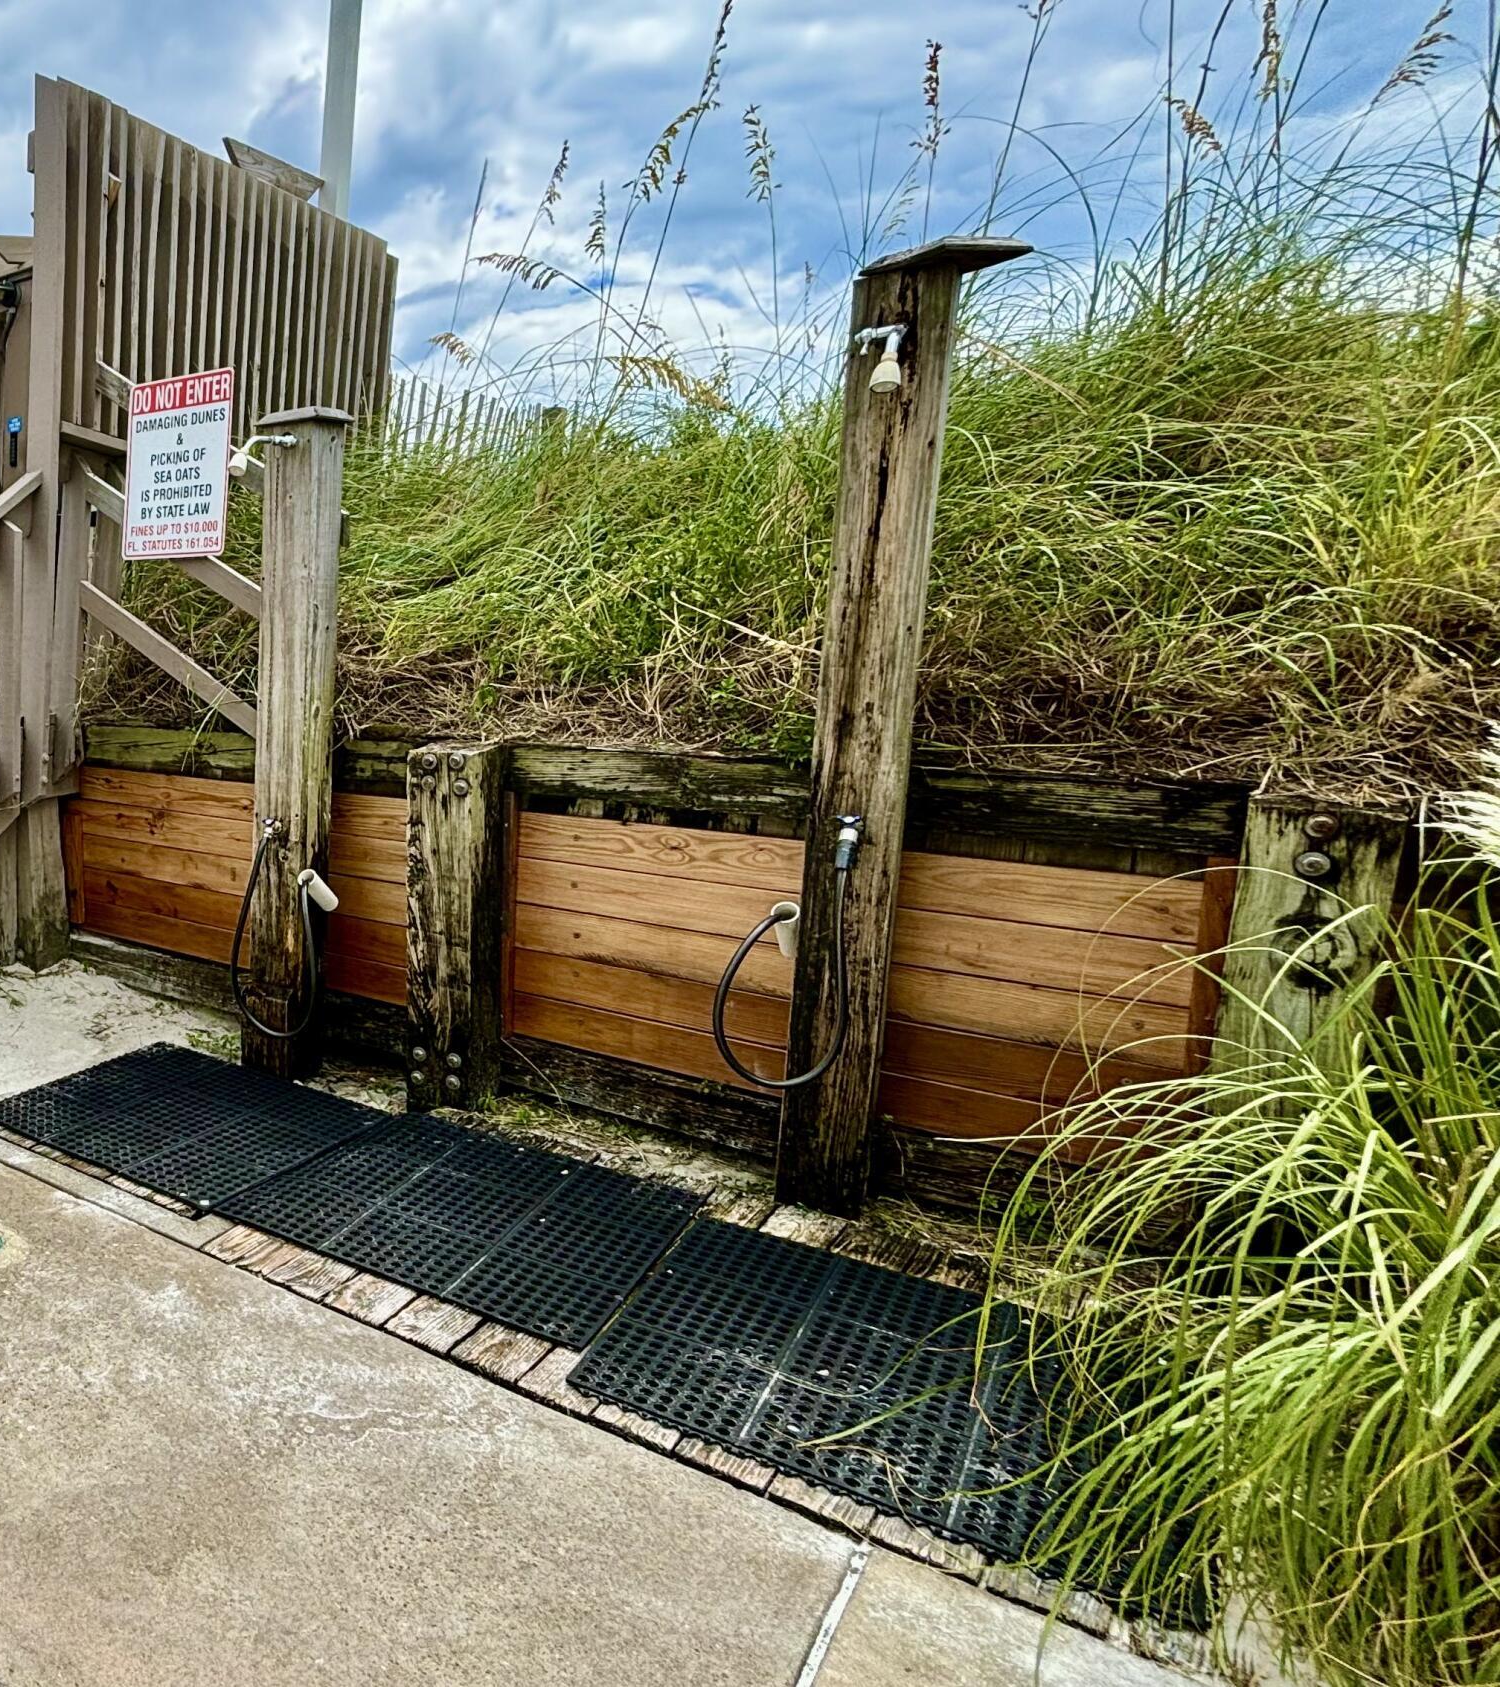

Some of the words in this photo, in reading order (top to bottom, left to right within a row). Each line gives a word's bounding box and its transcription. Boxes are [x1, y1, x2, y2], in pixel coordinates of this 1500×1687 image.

[133, 387, 152, 414] DO
[155, 381, 183, 411] NOT
[185, 373, 231, 406] ENTER
[135, 414, 188, 434] DAMAGING
[191, 407, 226, 425] DUNES
[176, 432, 184, 446] &
[150, 449, 190, 467] PICKING
[193, 447, 206, 462] OF
[153, 470, 172, 484] SEA
[175, 466, 201, 481] OATS
[141, 489, 150, 502] IS
[153, 483, 212, 501] PROHIBITED
[141, 506, 154, 520] BY
[156, 504, 185, 519] STATE
[187, 502, 211, 516] LAW
[130, 524, 154, 536] FINES
[156, 524, 169, 535] UP
[171, 523, 182, 534] TO
[183, 520, 219, 535] $10,000
[141, 539, 183, 552] STATUTES
[185, 536, 219, 549] 161.054
